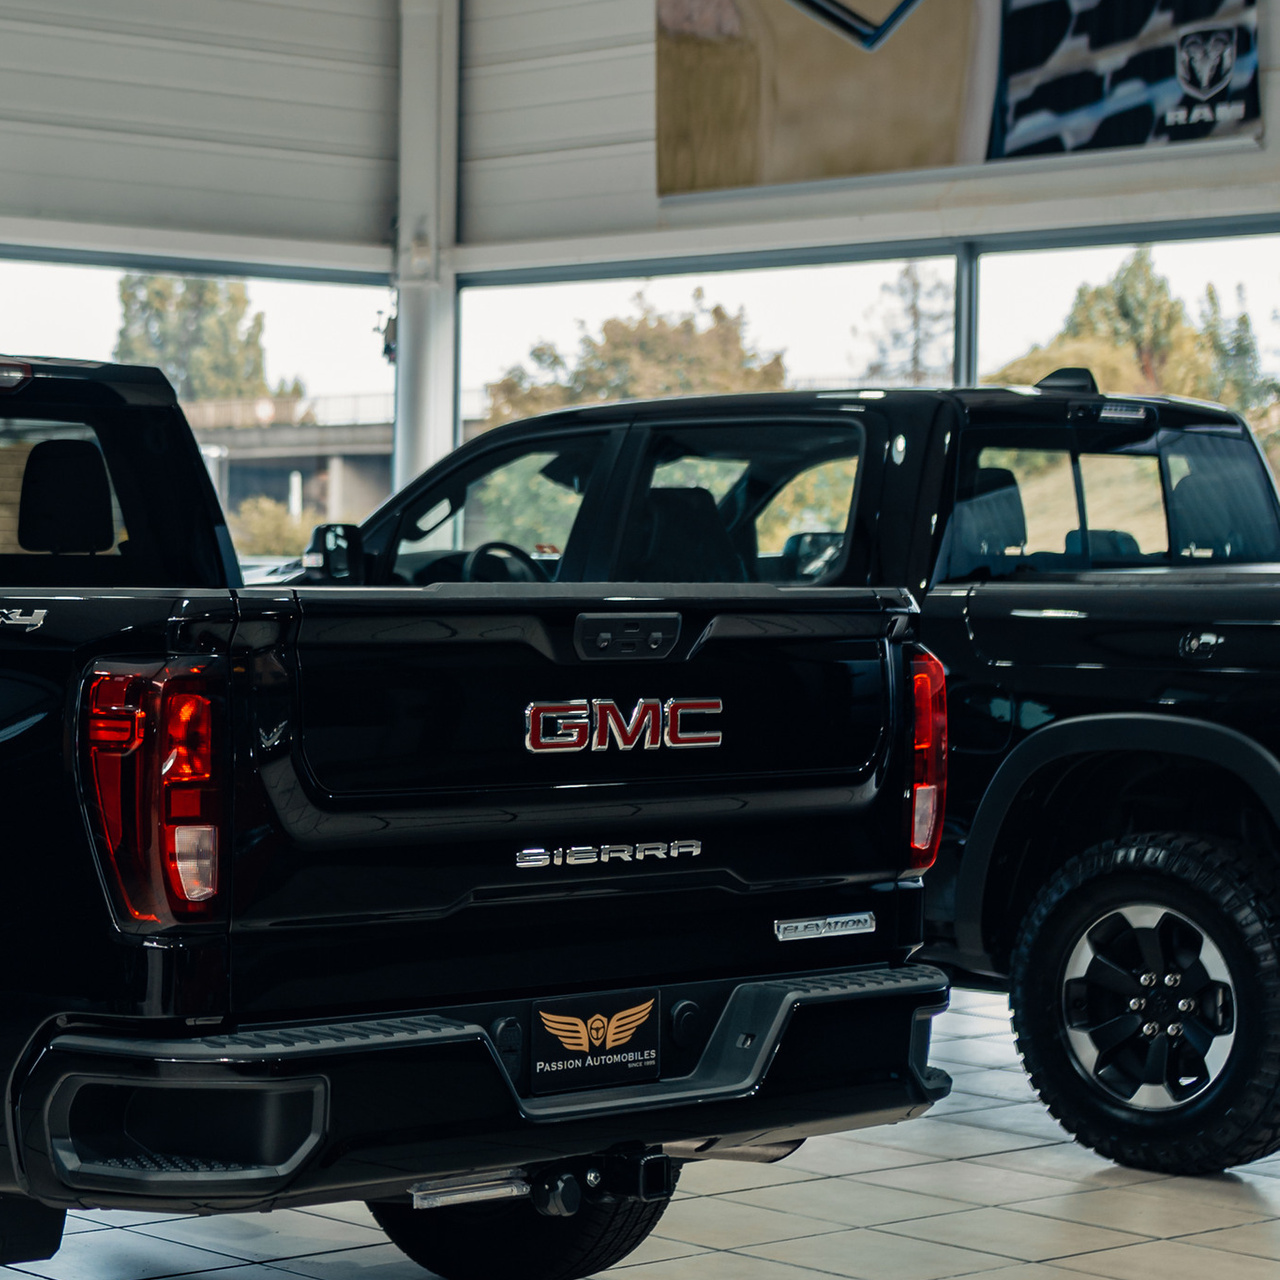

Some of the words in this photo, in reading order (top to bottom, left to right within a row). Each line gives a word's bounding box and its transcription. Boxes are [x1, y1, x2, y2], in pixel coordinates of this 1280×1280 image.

[1165, 101, 1245, 126] RAM
[524, 697, 723, 754] GMC
[515, 839, 702, 869] SIERRA
[782, 918, 869, 935] ELEVATION
[536, 1058, 583, 1074] PASSION
[585, 1048, 657, 1067] AUTOMOBILES
